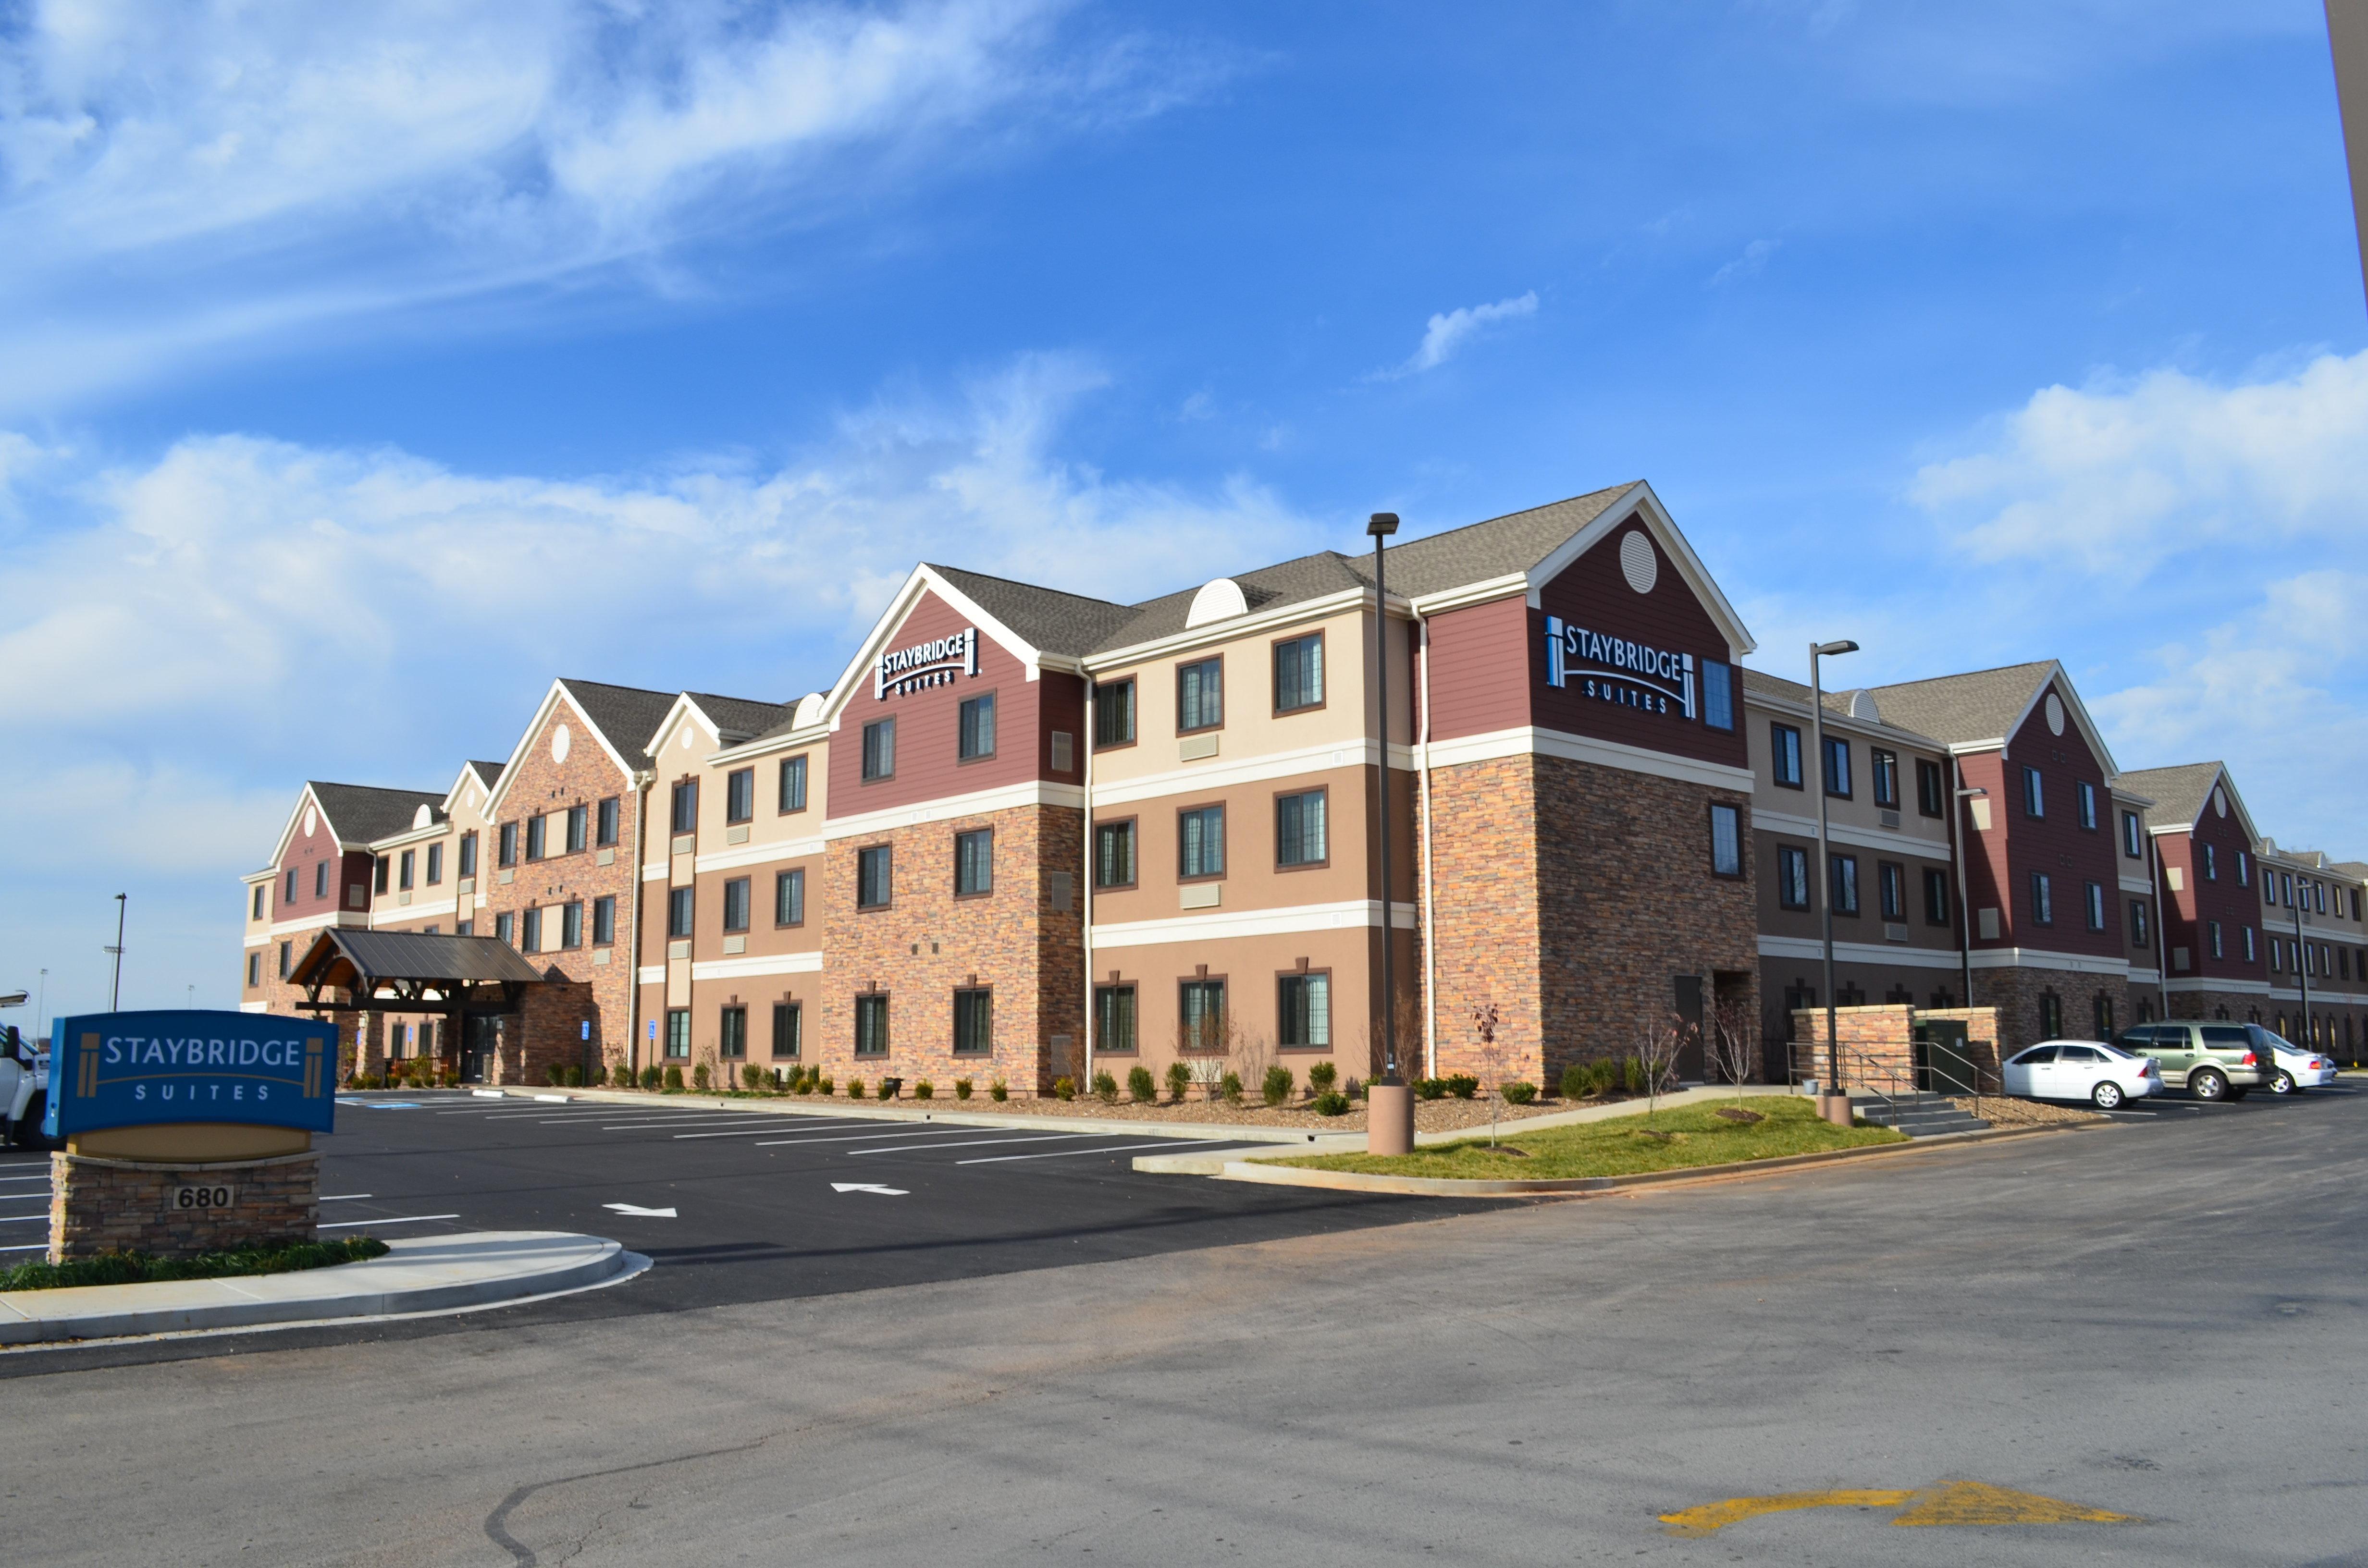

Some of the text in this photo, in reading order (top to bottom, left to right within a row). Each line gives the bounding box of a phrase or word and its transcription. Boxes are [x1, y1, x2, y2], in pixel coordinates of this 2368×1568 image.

[884, 633, 964, 674] STAYBRIDGE
[1566, 625, 1681, 681] STAYBRIDGE
[895, 670, 950, 695] SUITES
[1587, 679, 1666, 714] SUITES
[105, 1036, 300, 1066] STAYBRIDGE
[135, 1084, 269, 1101] SUITES
[178, 1188, 228, 1208] 680
